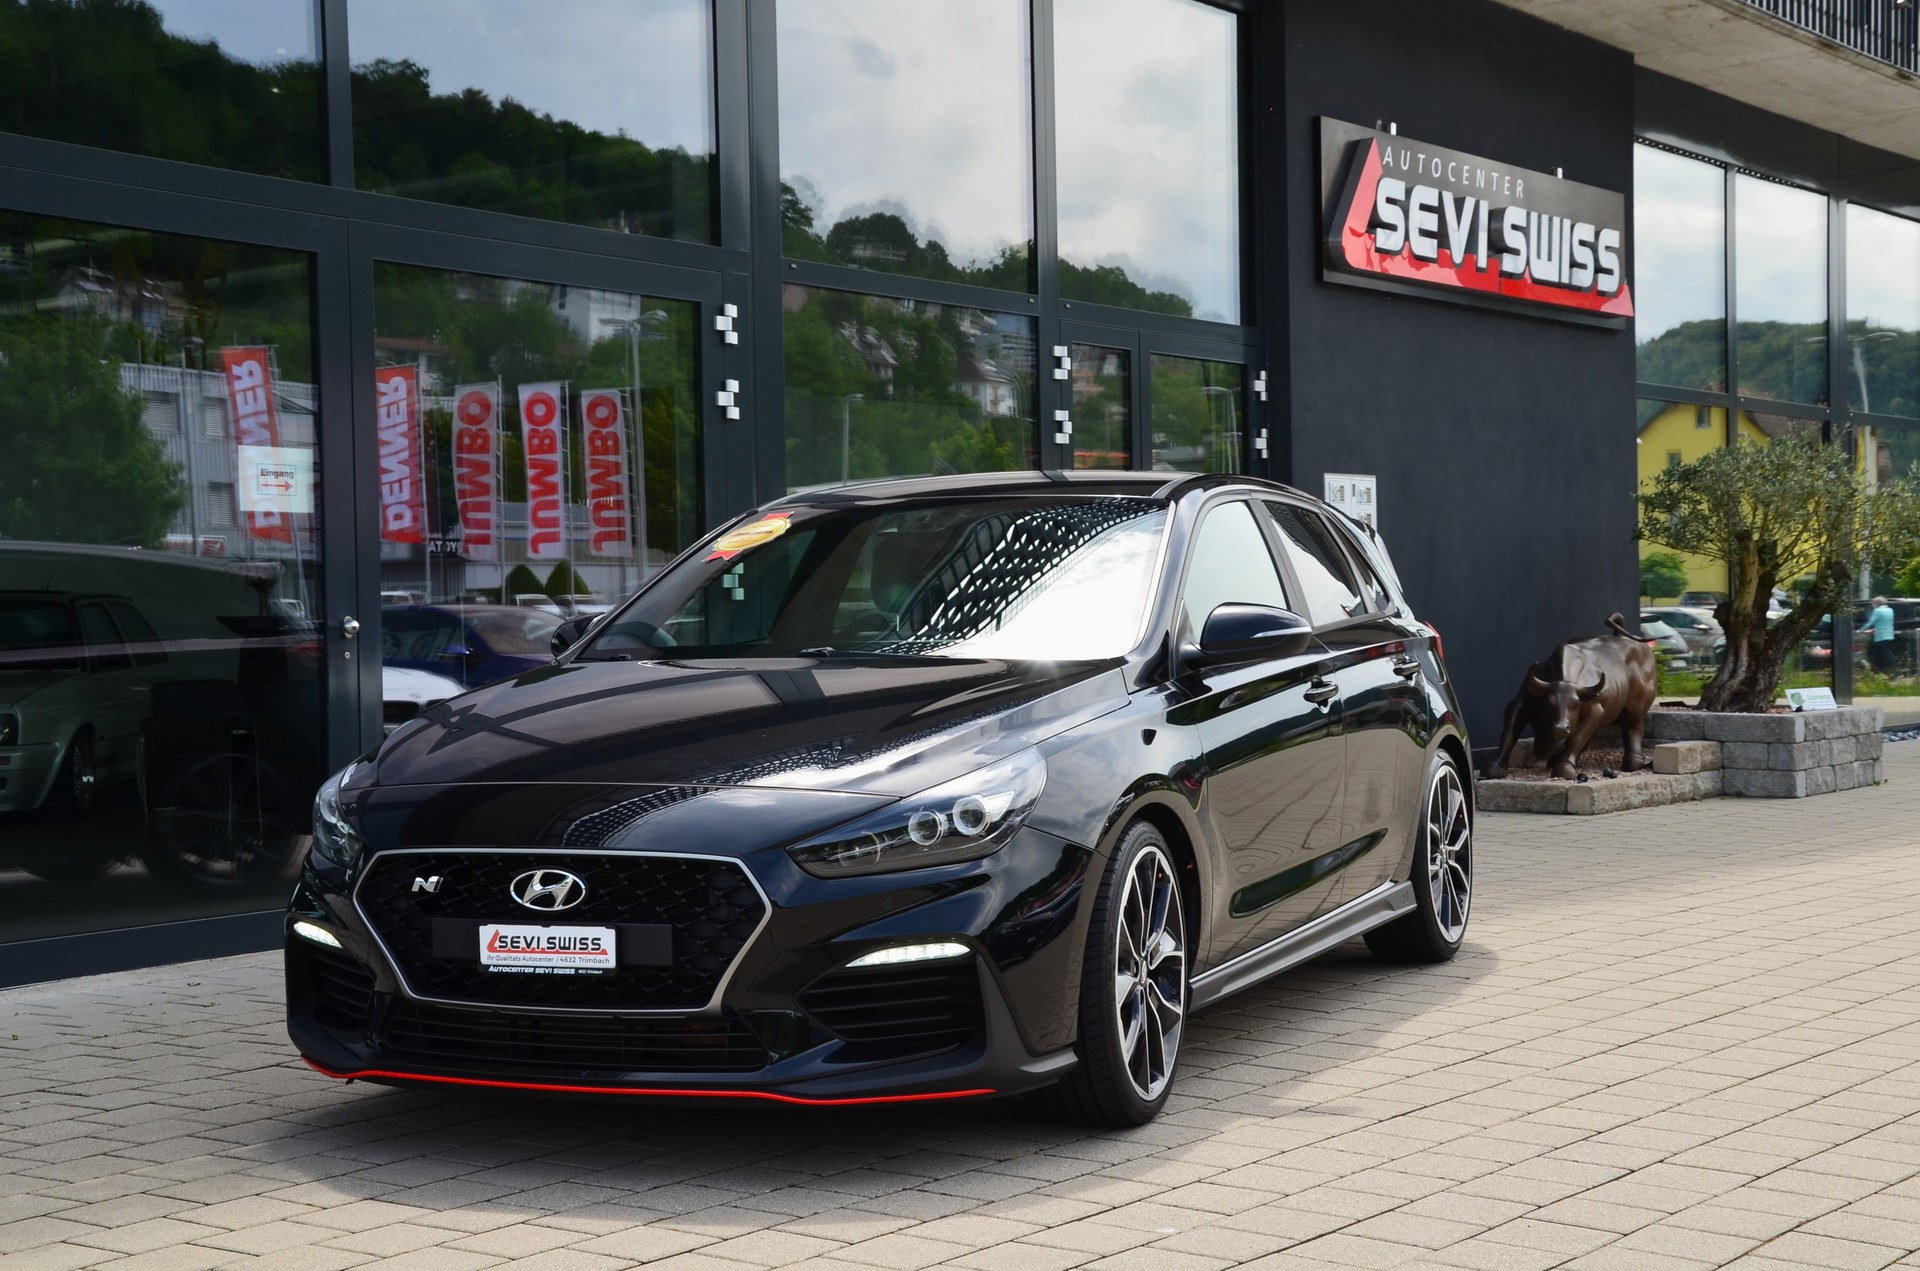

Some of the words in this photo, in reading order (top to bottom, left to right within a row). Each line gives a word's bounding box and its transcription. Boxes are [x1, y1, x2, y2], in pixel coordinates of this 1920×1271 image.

[1383, 146, 1524, 199] AUTOCENTER
[1375, 177, 1489, 270] SEVI
[1502, 205, 1620, 293] SWISS
[260, 468, 295, 479] Eingang
[498, 935, 541, 950] SEVI
[547, 936, 601, 951] SWISS
[578, 957, 610, 965] Trimbach
